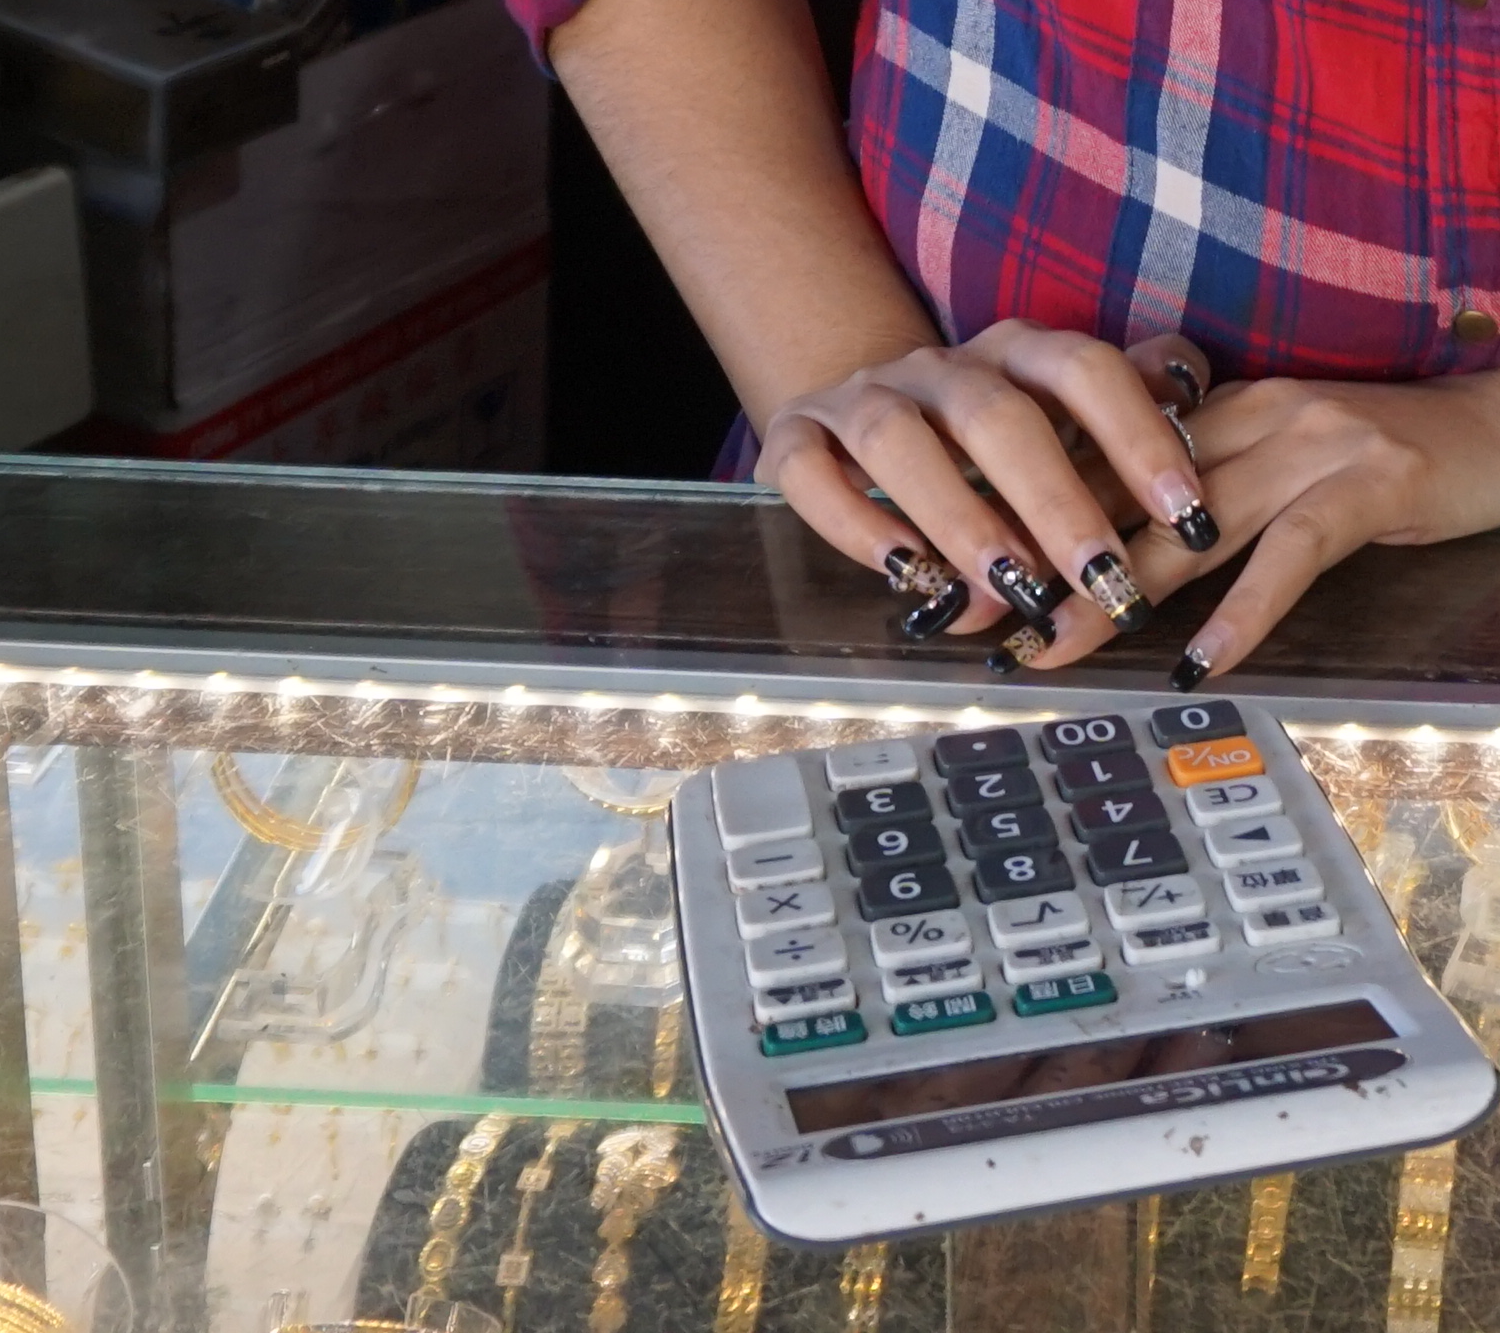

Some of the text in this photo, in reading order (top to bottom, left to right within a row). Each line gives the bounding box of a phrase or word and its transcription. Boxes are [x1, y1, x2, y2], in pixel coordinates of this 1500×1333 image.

[1179, 706, 1211, 730] 0
[1054, 718, 1117, 746] 00
[1174, 745, 1252, 767] ON/C
[1090, 759, 1114, 783] 1
[974, 772, 1007, 799] 2
[1203, 783, 1259, 806] CE
[864, 787, 896, 814] 3
[1100, 799, 1134, 824] 4
[990, 812, 1022, 839] 5
[1122, 838, 1154, 867] 7
[1002, 854, 1037, 882] 8
